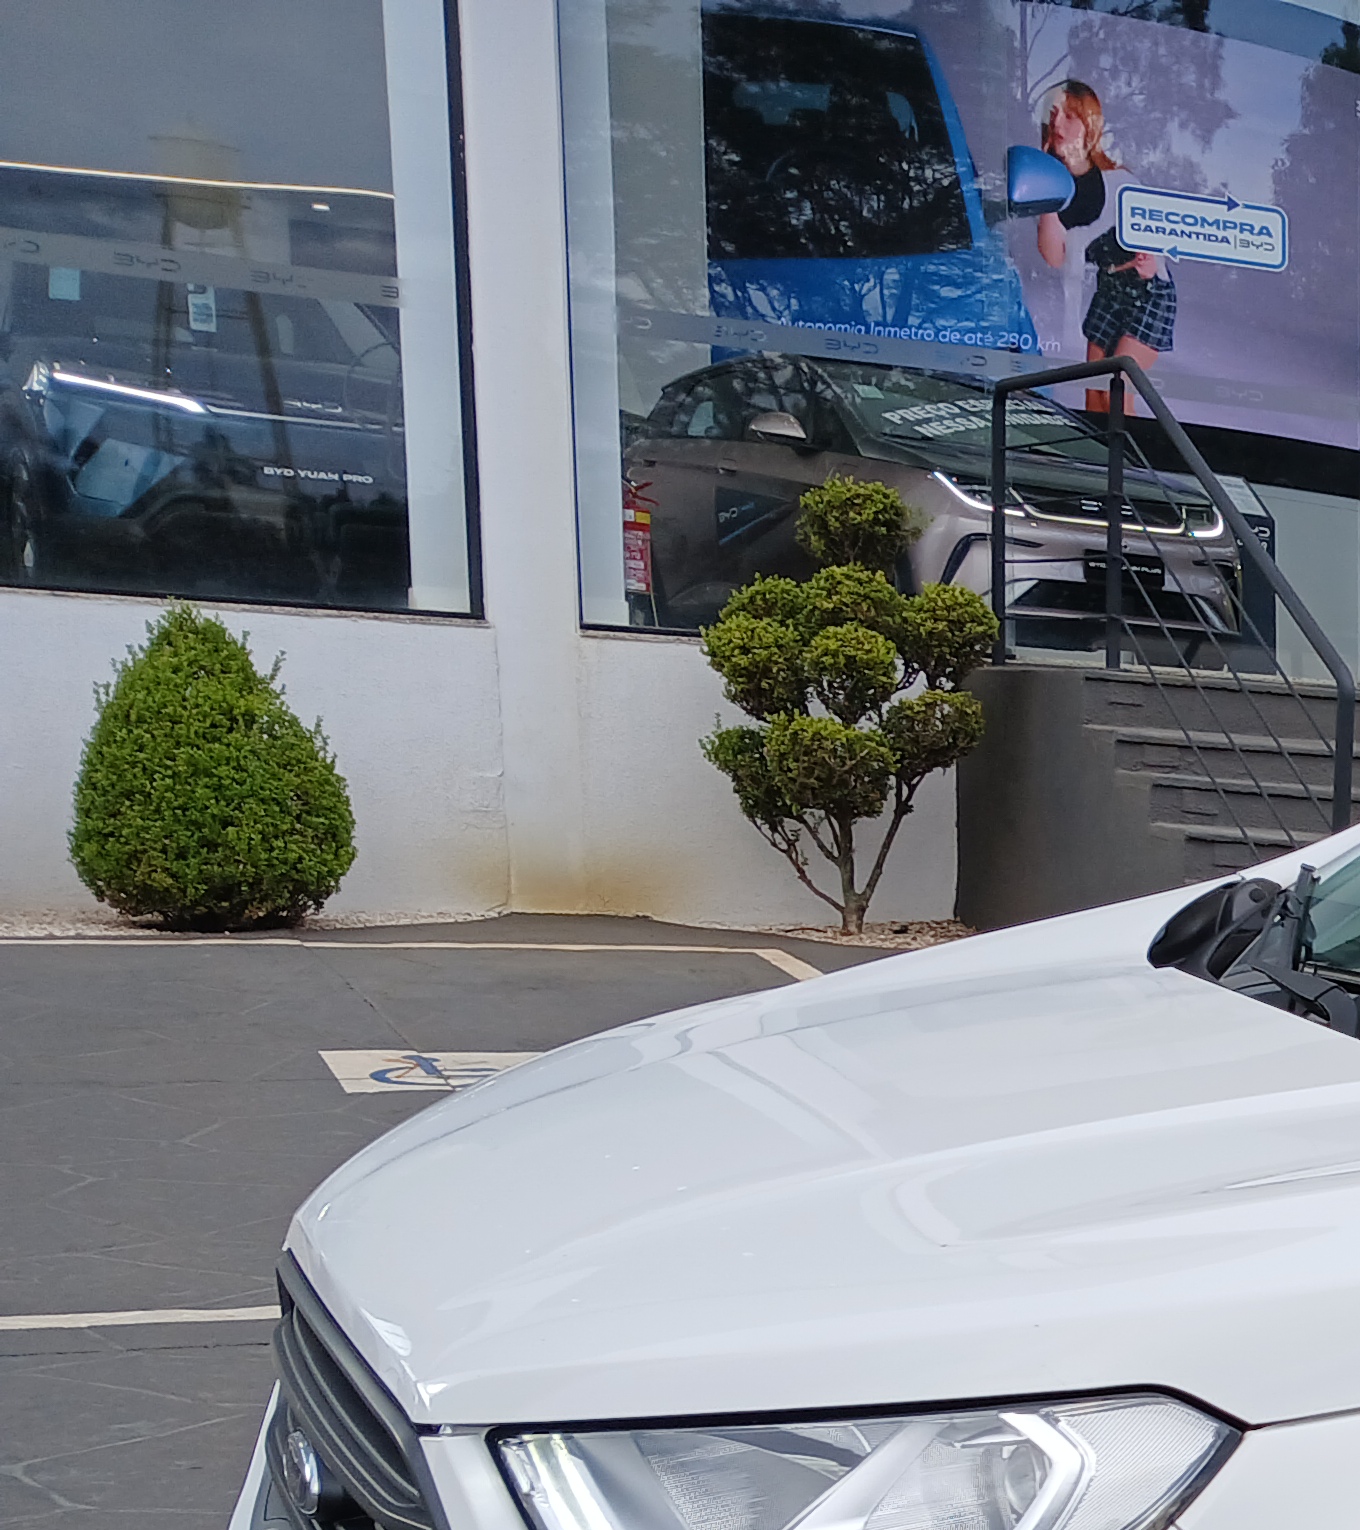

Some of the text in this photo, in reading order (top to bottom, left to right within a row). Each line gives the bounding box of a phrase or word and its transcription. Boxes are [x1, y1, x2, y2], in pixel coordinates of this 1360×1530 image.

[1130, 206, 1274, 239] RECOMPRA
[1130, 222, 1276, 252] GARANTIDA BYD
[870, 321, 935, 341] Inmetro
[939, 328, 960, 344] de
[964, 331, 993, 346] até
[1037, 335, 1061, 352] km
[881, 402, 961, 425] PREÇO
[263, 466, 374, 484] BYD YUAN PRO
